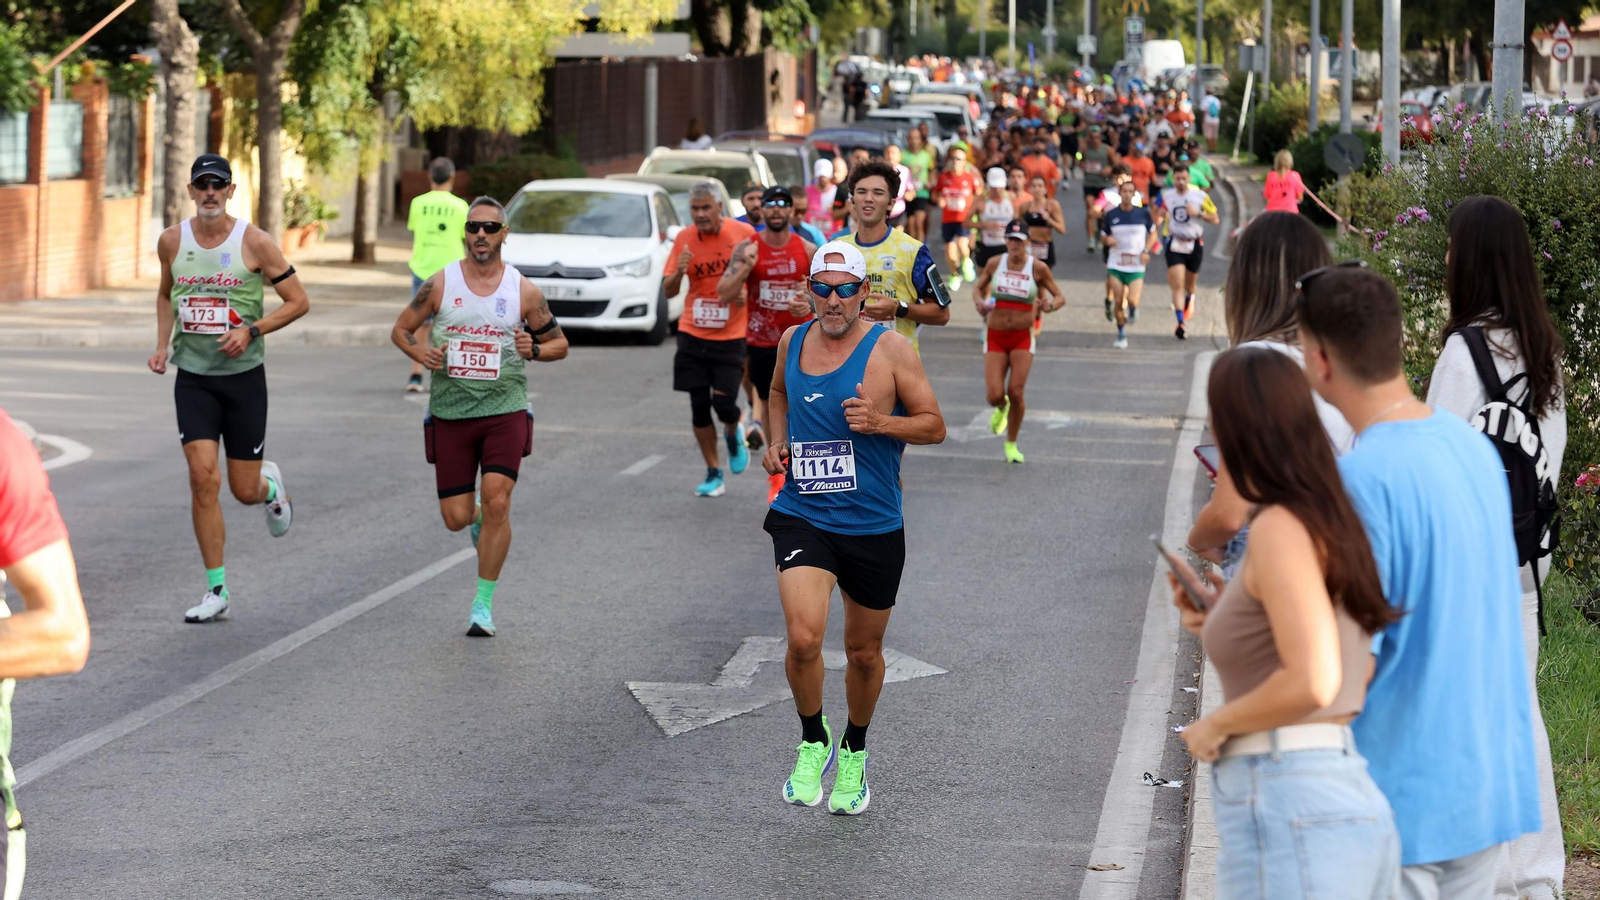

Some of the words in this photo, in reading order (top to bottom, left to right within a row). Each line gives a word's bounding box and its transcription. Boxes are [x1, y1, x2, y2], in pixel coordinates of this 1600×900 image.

[177, 272, 244, 287] maratón
[770, 291, 789, 300] 309
[191, 309, 215, 321] 173
[702, 308, 720, 317] 233
[446, 324, 505, 338] maratón
[461, 353, 487, 367] 150
[800, 458, 844, 477] 1114
